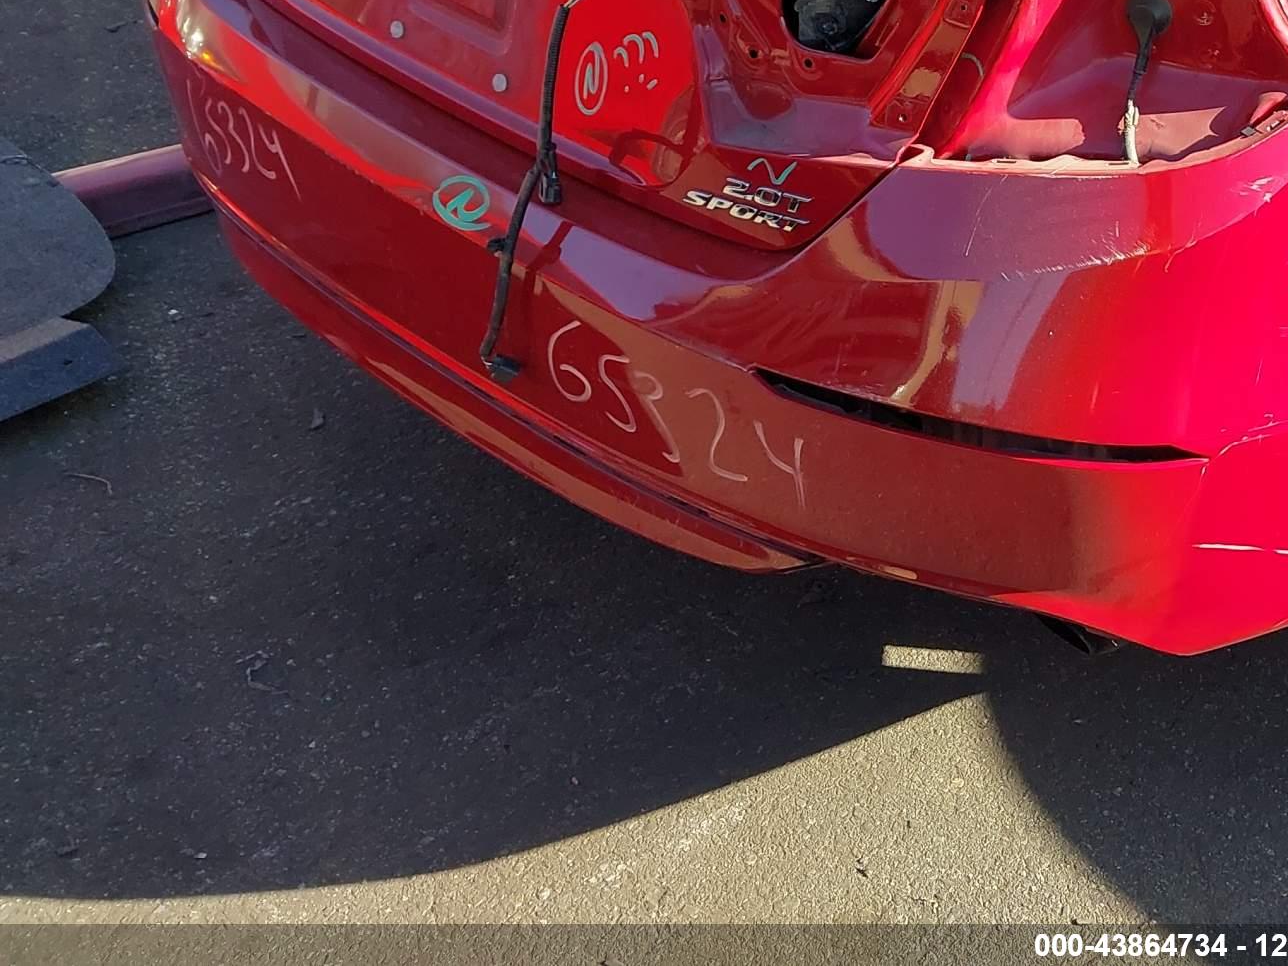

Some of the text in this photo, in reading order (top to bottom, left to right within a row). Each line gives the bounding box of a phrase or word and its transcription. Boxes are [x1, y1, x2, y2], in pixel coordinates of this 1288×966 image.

[683, 189, 811, 233] SPORT
[722, 177, 815, 213] 2.0T
[547, 320, 806, 510] 65324
